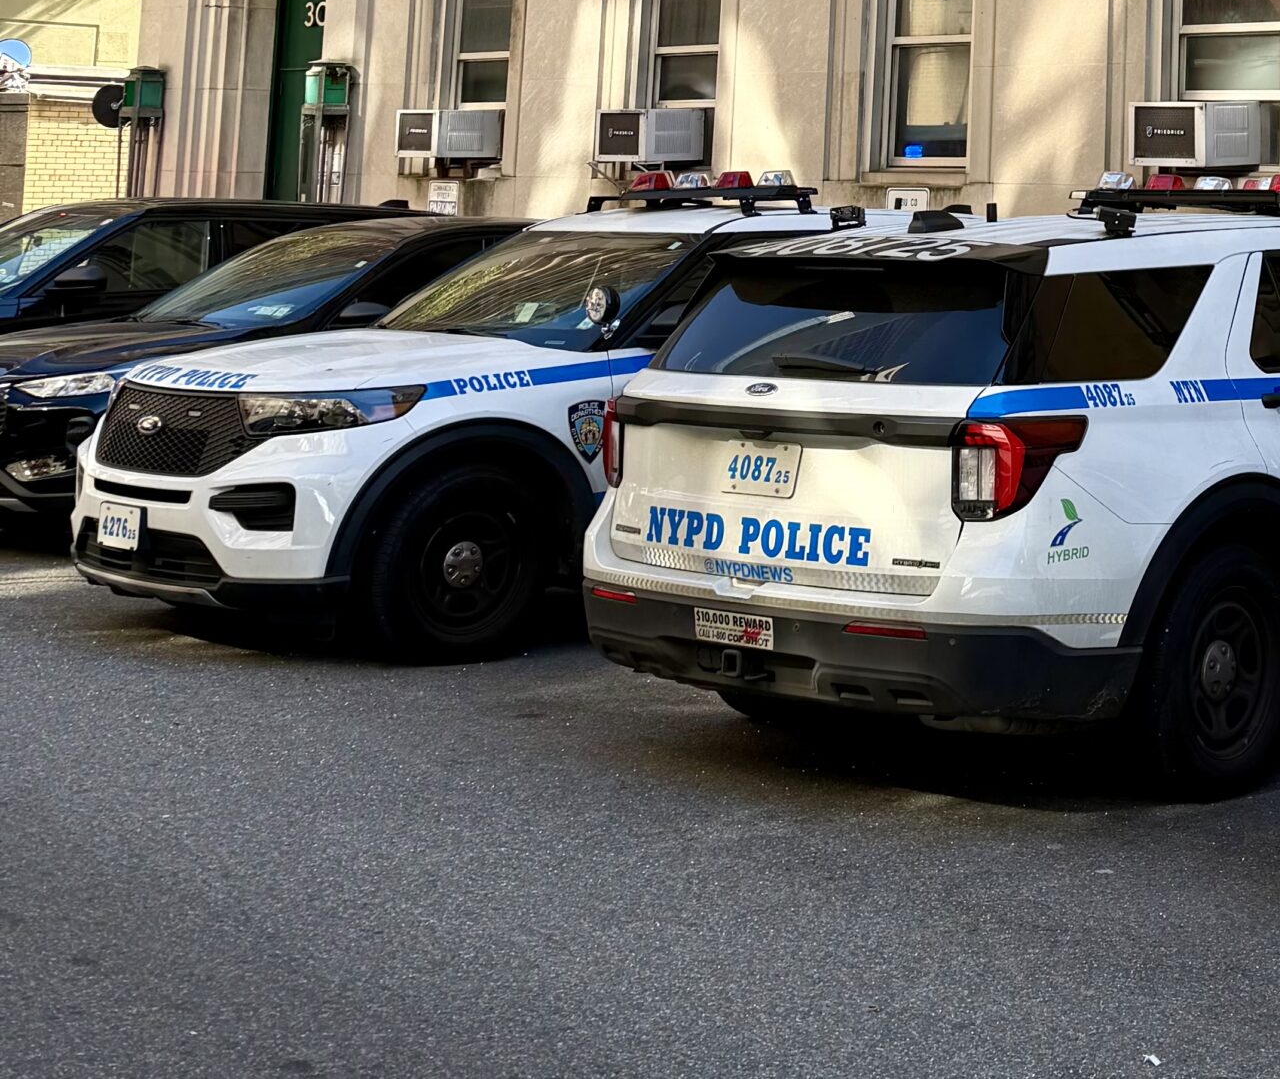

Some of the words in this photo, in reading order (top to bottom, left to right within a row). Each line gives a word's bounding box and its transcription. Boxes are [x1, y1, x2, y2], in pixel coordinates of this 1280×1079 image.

[133, 364, 184, 381] NYPD
[171, 369, 259, 389] POLICE
[453, 370, 531, 395] POLICE
[1085, 383, 1125, 408] 4087
[1124, 393, 1136, 406] 25
[1169, 380, 1205, 403] MTN
[579, 402, 599, 410] POLICE
[728, 454, 777, 483] 4087
[775, 470, 790, 484] 25
[102, 515, 128, 539] 4276
[127, 529, 136, 540] 25
[646, 506, 725, 551] NYPD
[739, 517, 871, 567] POLICE
[1047, 546, 1090, 565] HYBRID
[704, 558, 794, 583] @NYPDNEWS
[696, 609, 730, 625] $10,000
[732, 616, 771, 631] REWARD
[698, 628, 711, 639] CALL
